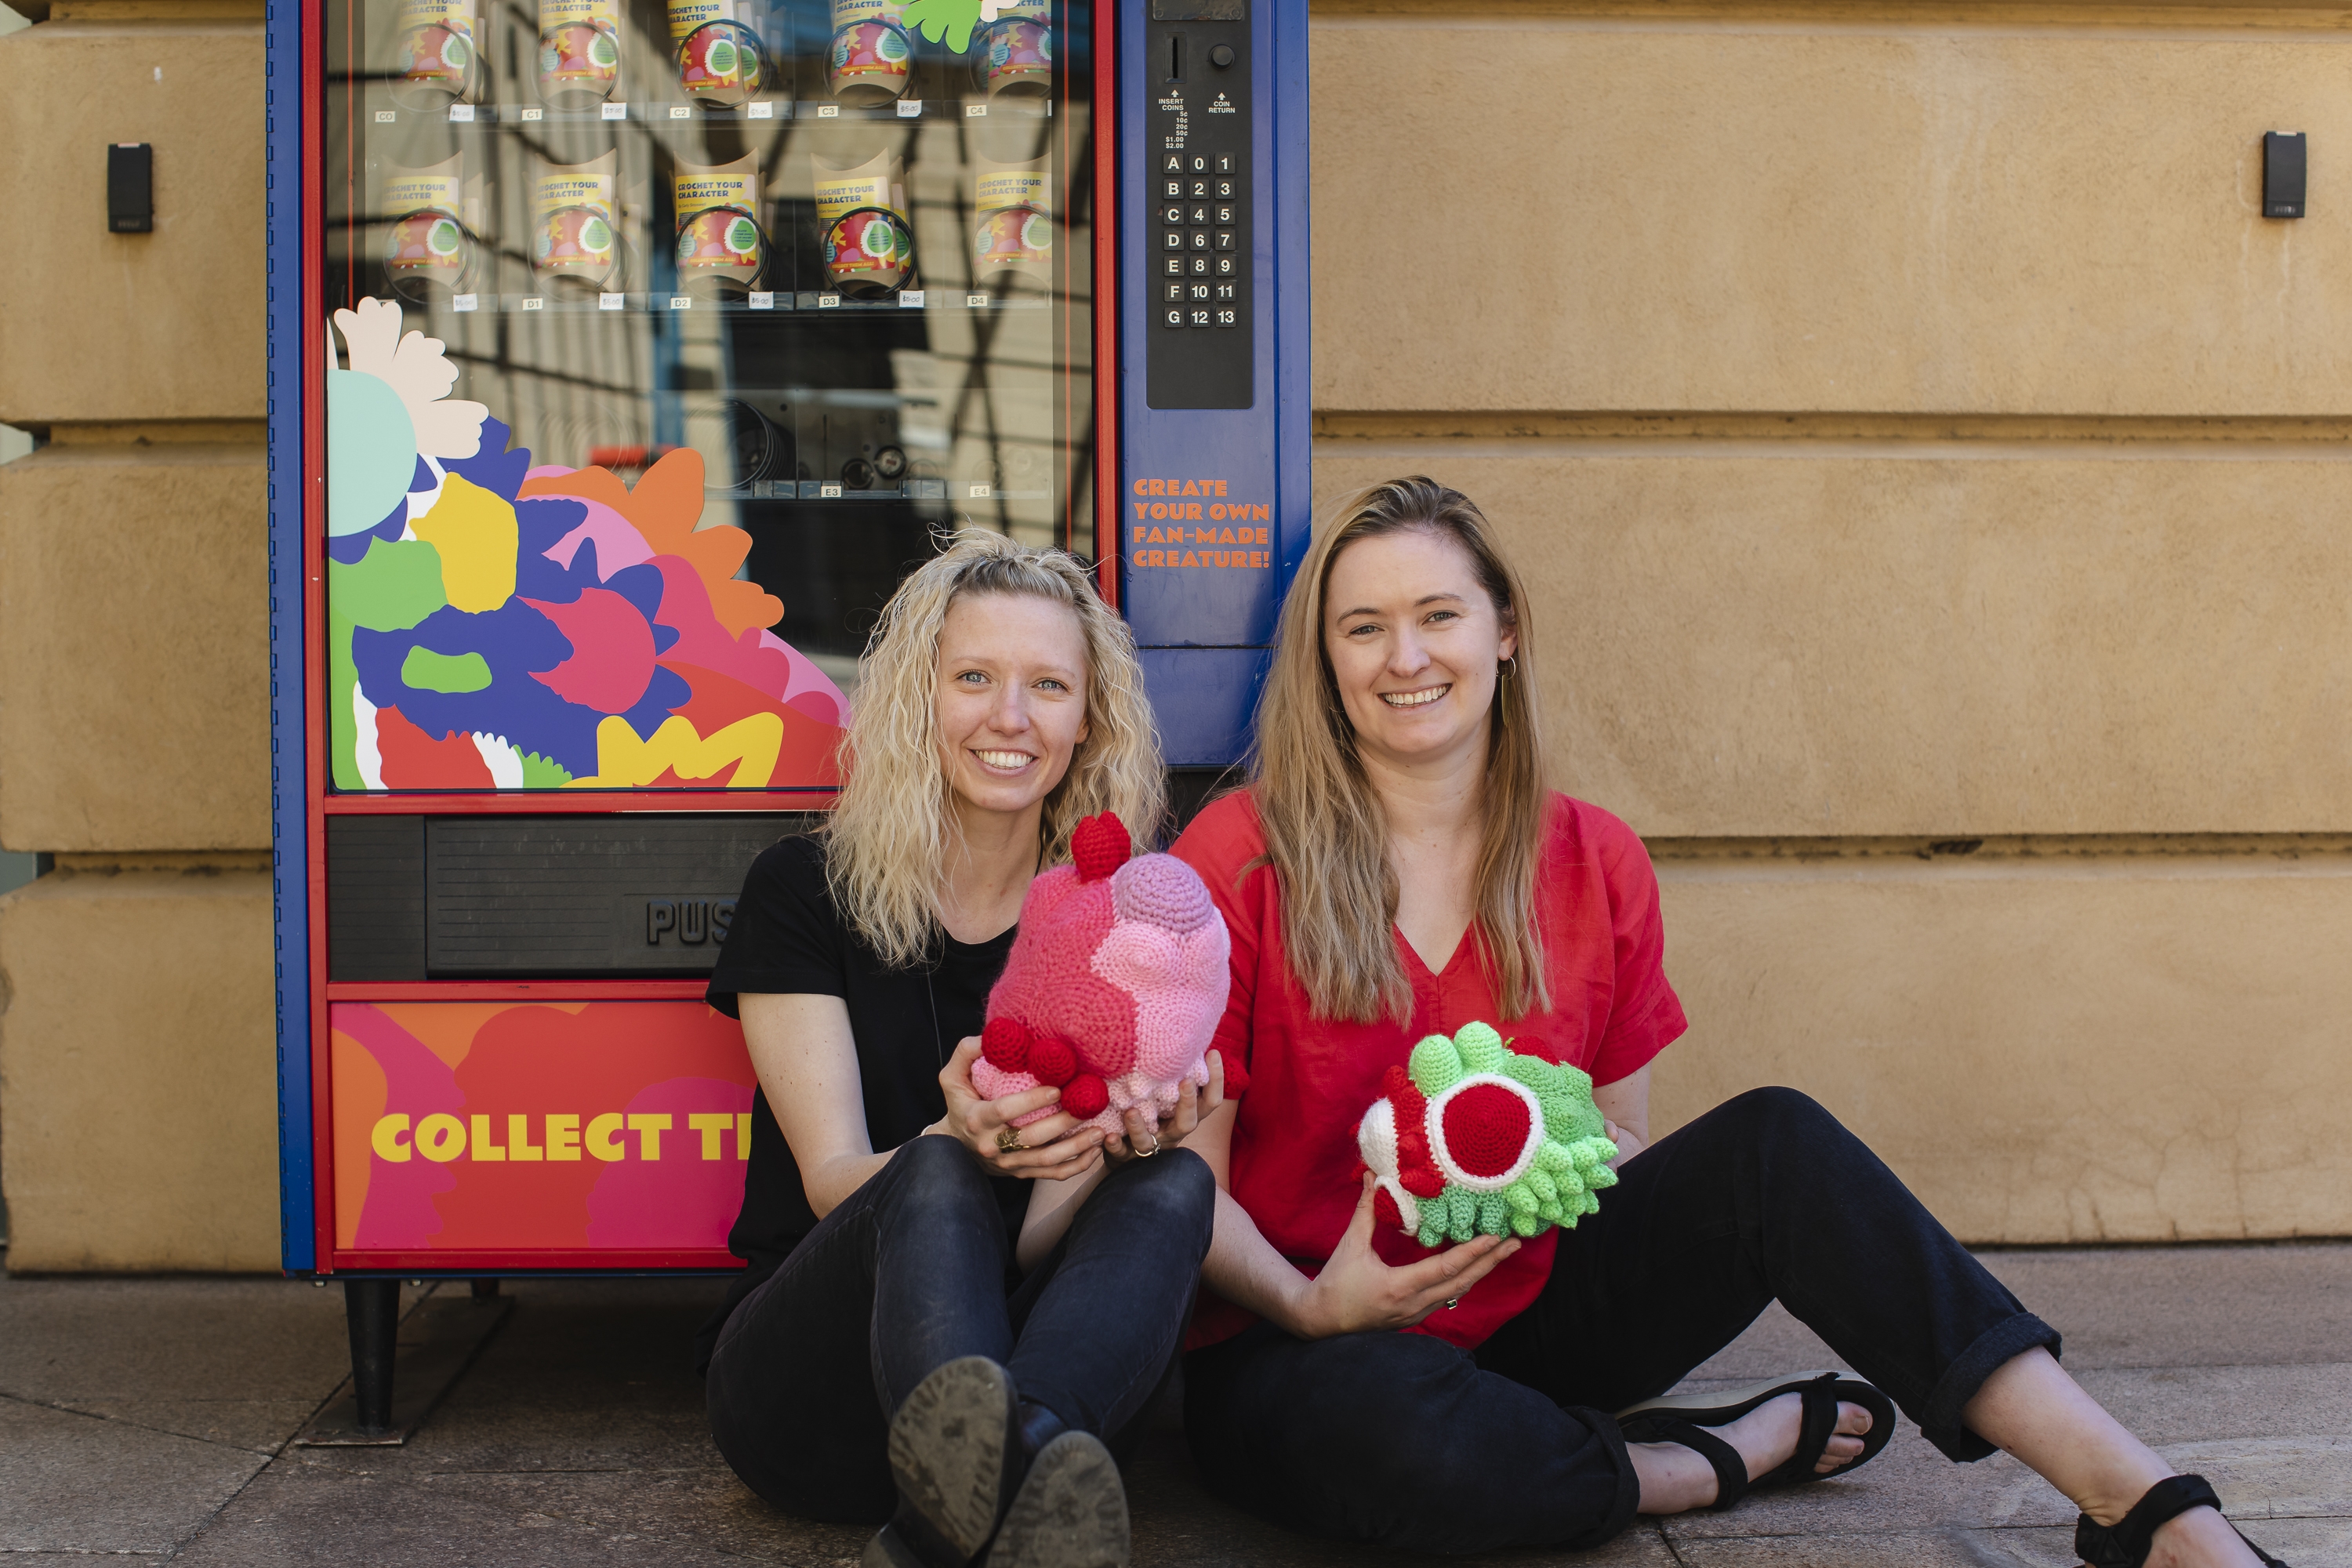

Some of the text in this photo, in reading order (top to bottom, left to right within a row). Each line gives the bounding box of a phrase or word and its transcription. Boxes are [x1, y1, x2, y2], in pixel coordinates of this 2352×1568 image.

[527, 111, 539, 119] C1
[674, 108, 687, 117] C2
[1167, 157, 1229, 170] A 0 1
[677, 181, 713, 191] CROCHET
[848, 185, 875, 194] YOUR
[979, 179, 1013, 190] CROCHET
[1168, 183, 1230, 195] B 2 3
[677, 190, 729, 199] CHARACTER
[978, 187, 1028, 198] CHARACTER
[817, 194, 862, 205] CHARACTER
[1167, 209, 1230, 221] C 4 5
[1168, 234, 1230, 247] D 6 7
[1169, 260, 1231, 272] E 8 9
[1171, 285, 1232, 298] F 10 11
[675, 299, 688, 307] D2
[823, 297, 836, 306] D3
[1168, 310, 1234, 324] G 12 13
[825, 488, 839, 497] E3
[1133, 478, 1228, 497] CREATE
[1133, 503, 1269, 521] YOUR OWN
[1133, 526, 1269, 545] FAN-MADE
[1133, 550, 1270, 568] CREATURE!
[371, 1112, 673, 1163] COLLECT
